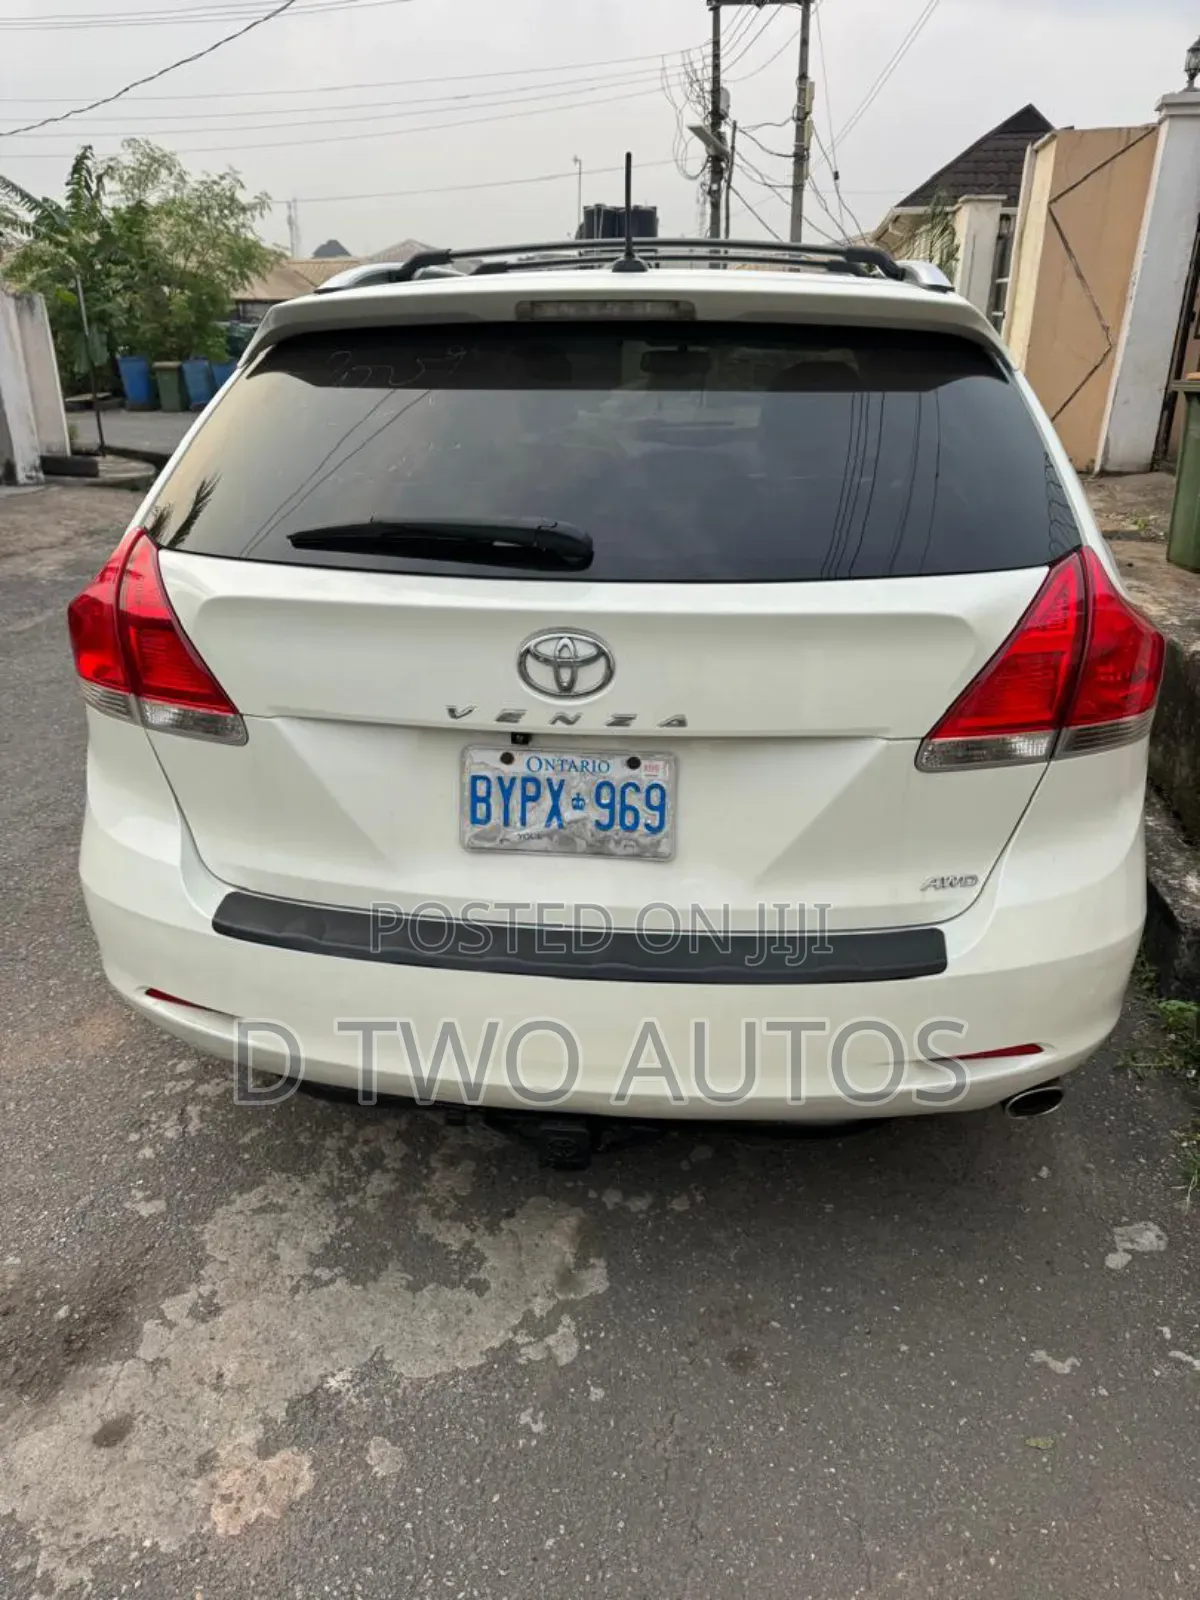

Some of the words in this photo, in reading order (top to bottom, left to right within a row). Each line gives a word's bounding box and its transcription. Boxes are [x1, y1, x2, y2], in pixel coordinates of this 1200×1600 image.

[446, 705, 688, 728] VENZA
[526, 756, 610, 774] ONTARIO
[470, 775, 565, 829] BYPX
[594, 781, 666, 835] 969
[920, 874, 978, 891] AWD
